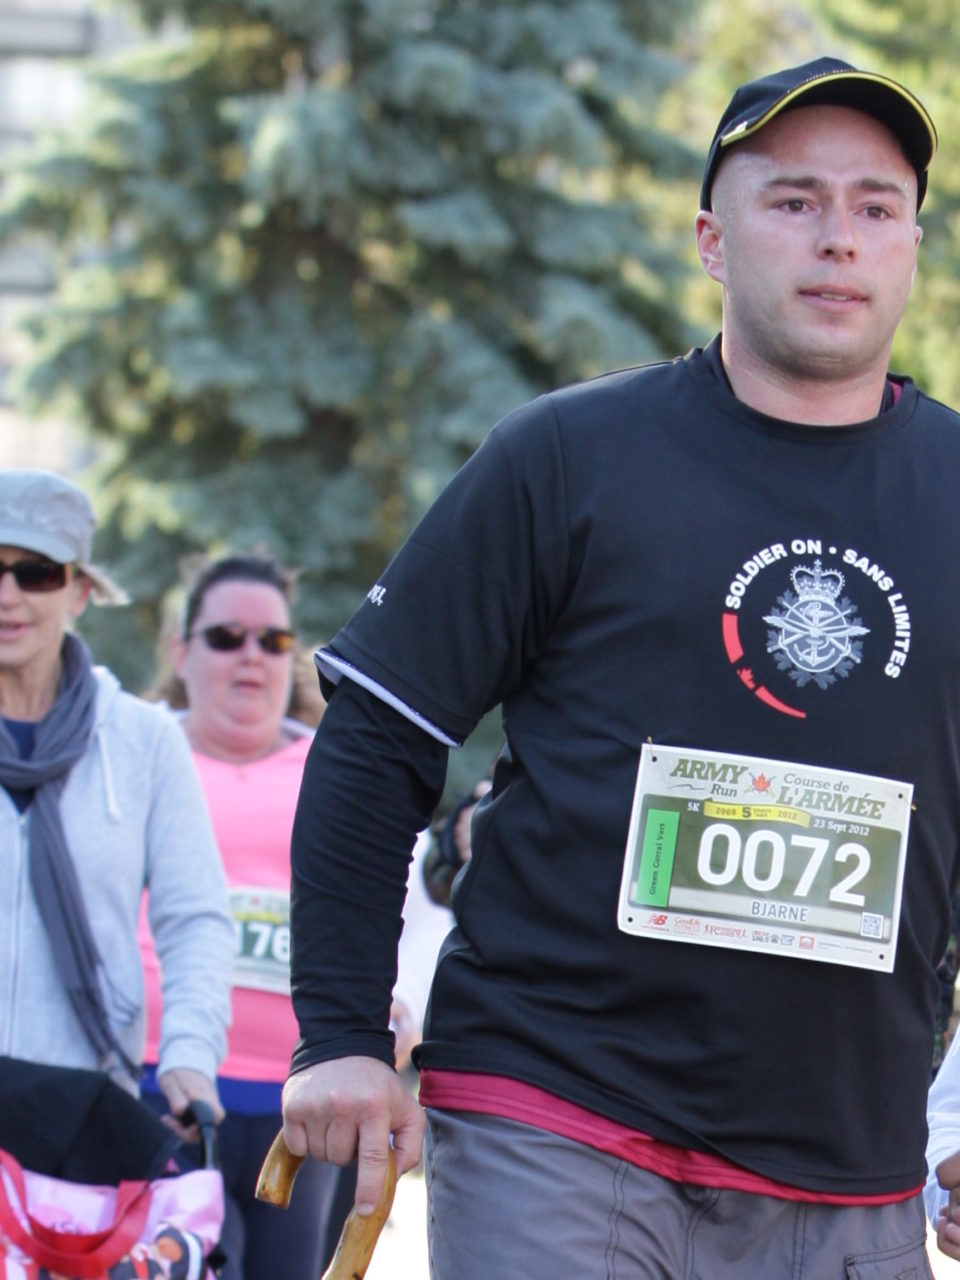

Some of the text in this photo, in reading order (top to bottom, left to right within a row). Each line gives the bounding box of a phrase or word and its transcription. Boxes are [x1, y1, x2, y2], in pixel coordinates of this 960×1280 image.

[725, 539, 911, 679] SOLDIER ON SANS LIMITES
[670, 758, 749, 784] ARMY
[710, 783, 738, 798] Run
[783, 772, 850, 793] Course de
[687, 801, 701, 812] 5K
[742, 806, 752, 818] 5
[776, 785, 886, 820] L'ARMÉE
[813, 818, 870, 836] 23 Sept 2012
[697, 823, 872, 907] 0072
[751, 901, 809, 922] BJARNE
